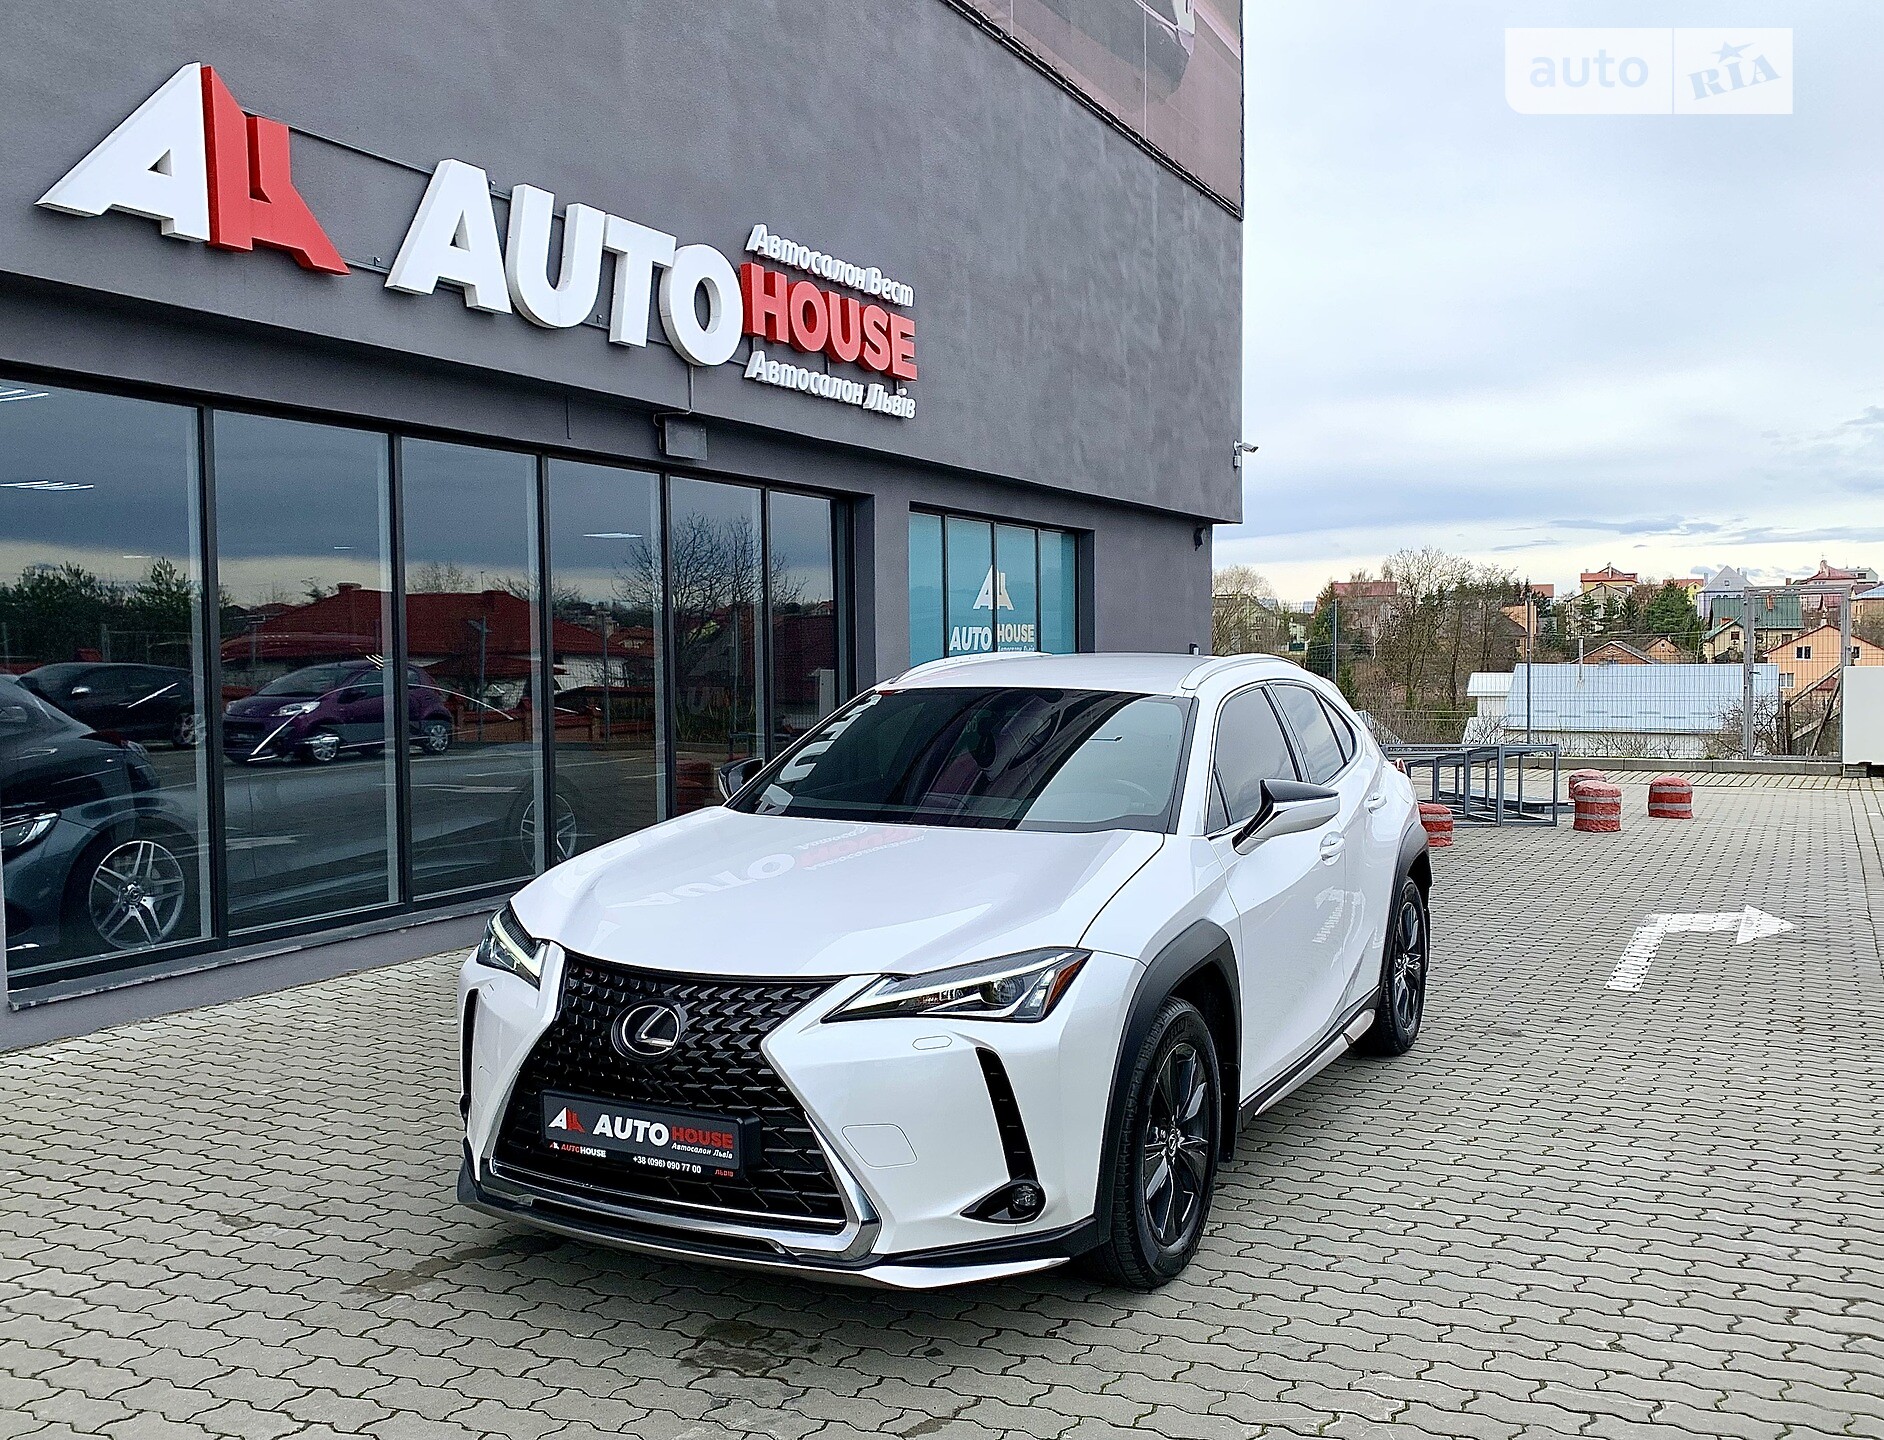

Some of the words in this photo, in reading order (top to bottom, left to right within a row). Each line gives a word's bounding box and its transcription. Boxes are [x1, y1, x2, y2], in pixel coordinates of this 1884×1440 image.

[387, 158, 743, 366] AUTO
[745, 223, 868, 293] Автосалон
[864, 266, 915, 308] Вест
[740, 261, 917, 382] HOUSE
[744, 349, 865, 405] Автосалон
[863, 382, 917, 419] Львів
[949, 626, 992, 651] AUTO
[997, 623, 1034, 643] HOUSE
[592, 1113, 670, 1147] AUTO
[671, 1126, 734, 1150] HOUSE
[671, 1142, 711, 1155] Автосалон
[632, 1155, 646, 1165] +38
[647, 1157, 666, 1168] (096)
[666, 1160, 680, 1171] 090
[681, 1162, 691, 1172] 77
[691, 1164, 702, 1174] 00
